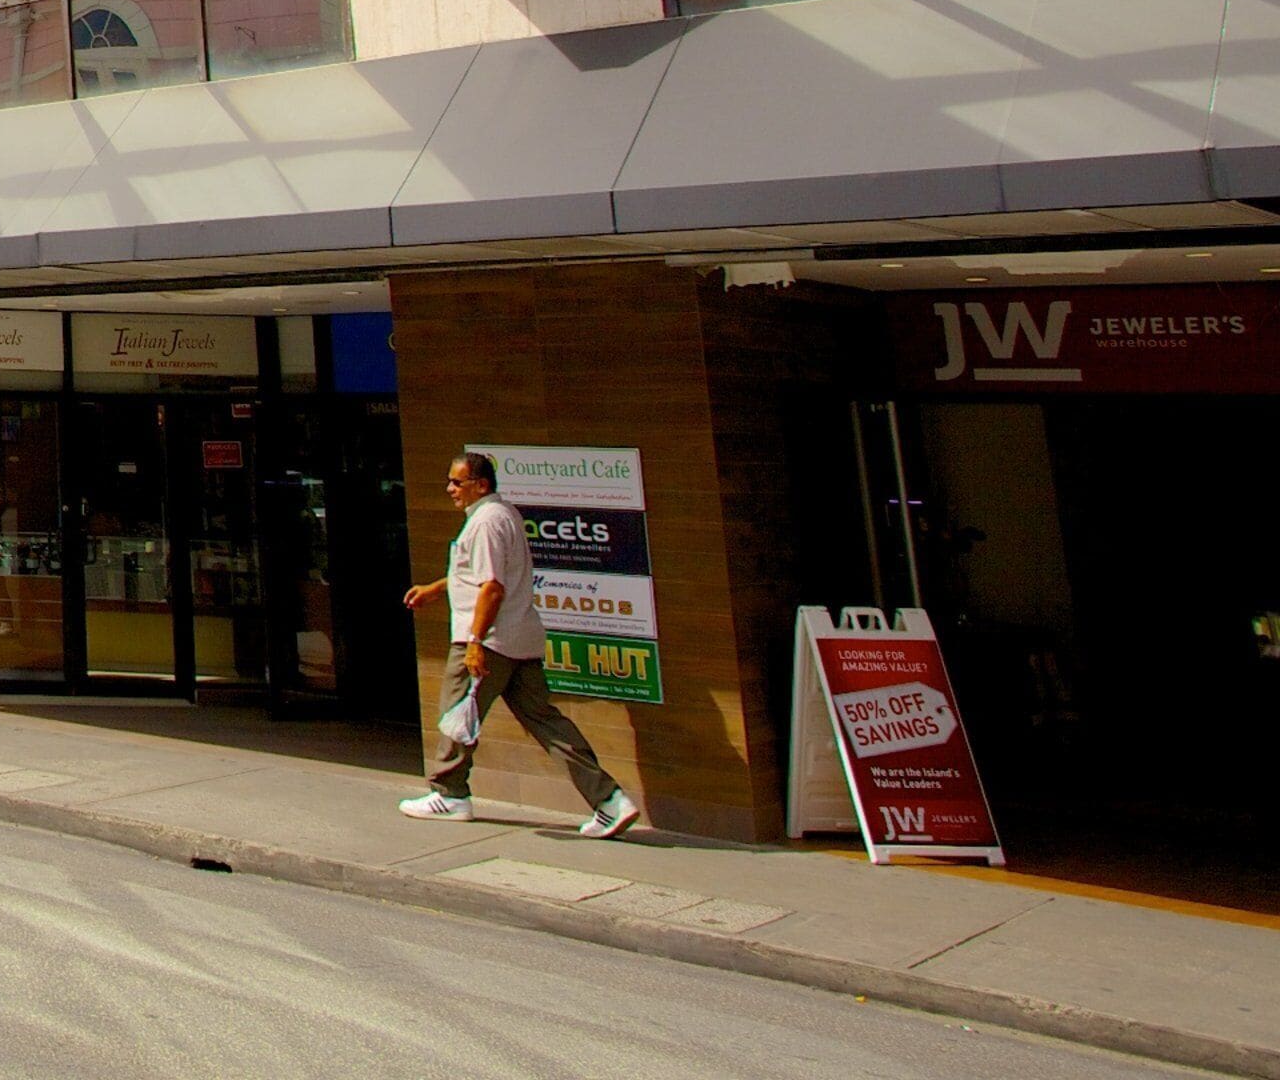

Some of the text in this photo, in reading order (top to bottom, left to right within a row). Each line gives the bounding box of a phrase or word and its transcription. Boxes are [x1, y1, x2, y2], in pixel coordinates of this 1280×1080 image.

[1090, 315, 1246, 336] JEWELER'S
[110, 327, 216, 357] Italian Jewels
[934, 300, 1073, 381] JW
[1095, 338, 1188, 349] warehouse
[145, 358, 154, 369] &
[504, 458, 631, 481] Courtyard Café
[523, 515, 610, 543] acets
[571, 543, 612, 553] Jewellers
[586, 581, 599, 594] of
[533, 593, 633, 616] RBADOS
[544, 639, 651, 681] LL HUT
[838, 650, 905, 660] LOOKING FOR
[842, 662, 928, 673] AMAZING VALUE?
[844, 692, 925, 723] 50% OFF
[855, 715, 940, 746] SAVINGS
[870, 767, 961, 778] We are the Island's
[874, 778, 901, 789] Value
[878, 806, 977, 841] JW JEWELER'S
